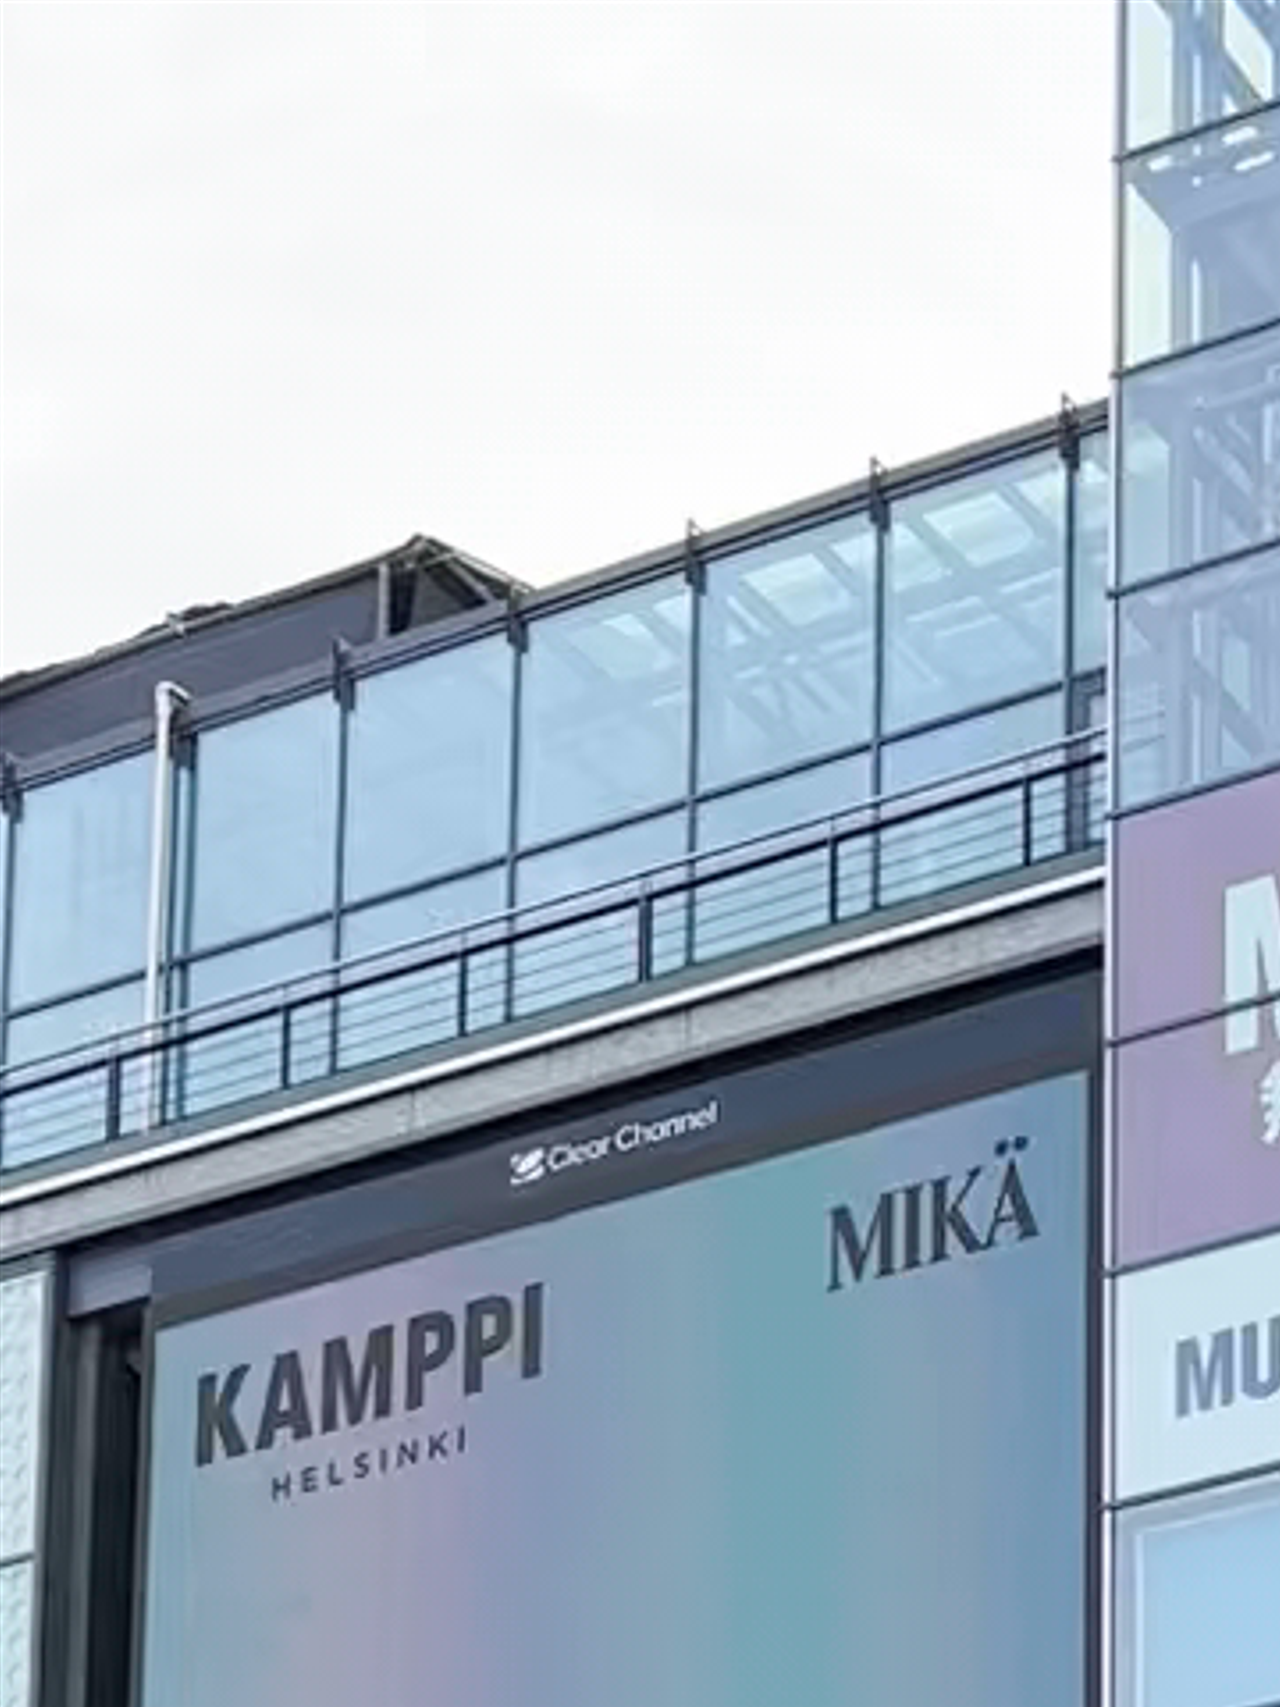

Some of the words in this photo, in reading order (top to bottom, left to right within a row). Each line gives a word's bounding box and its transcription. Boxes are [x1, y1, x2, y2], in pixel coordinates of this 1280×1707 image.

[547, 1137, 611, 1172] Clear
[615, 1101, 719, 1151] Channel
[823, 1135, 1040, 1292] MIKÄ
[193, 1281, 545, 1468] KAMPPI
[270, 1426, 468, 1503] HELSINKI
